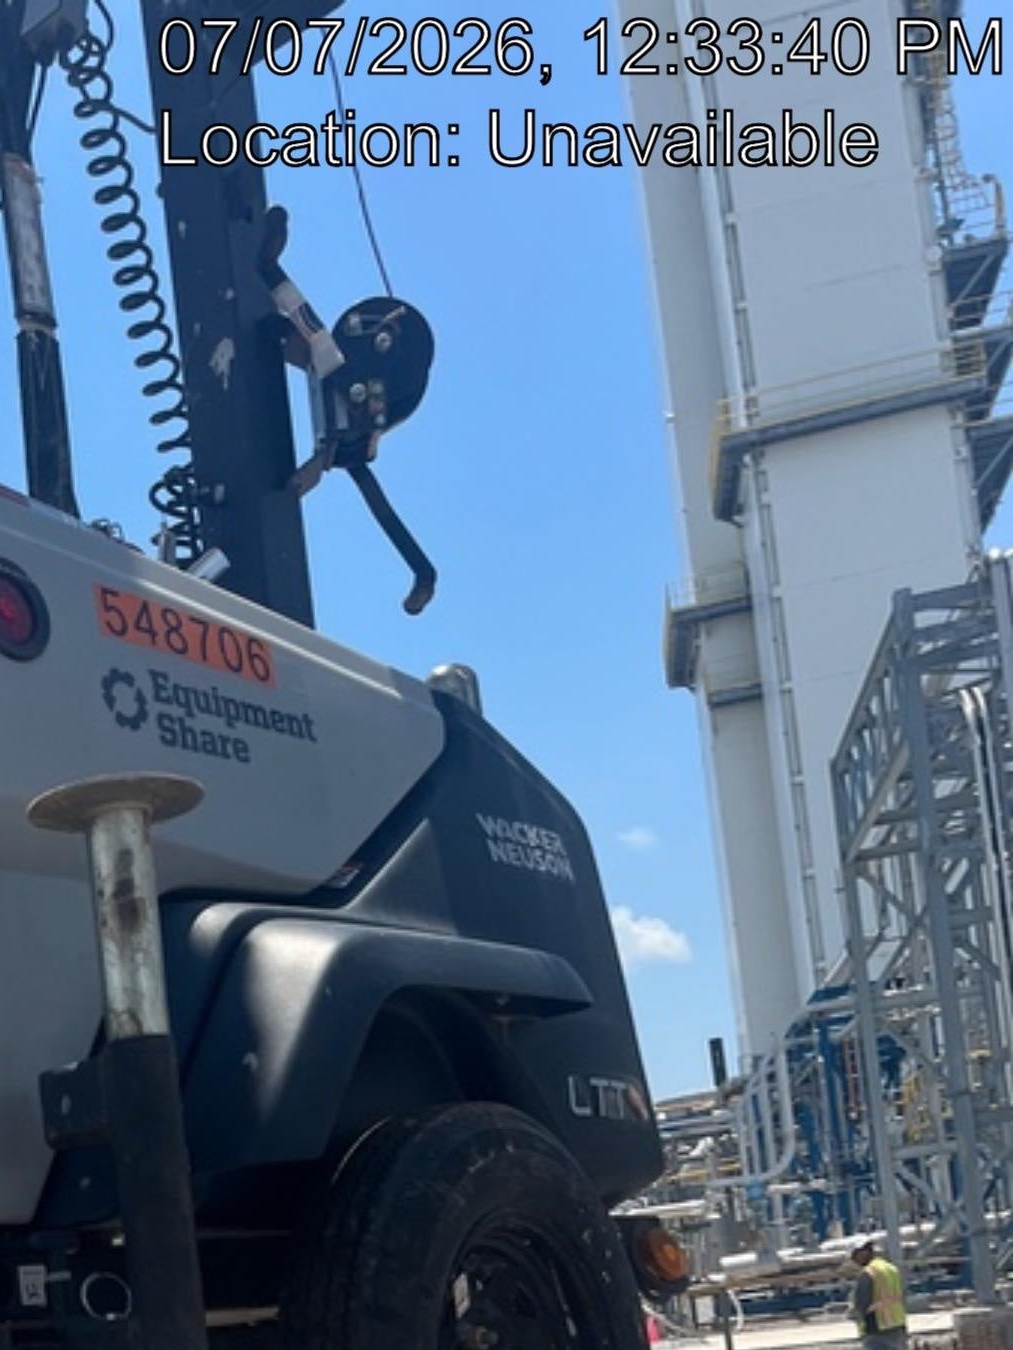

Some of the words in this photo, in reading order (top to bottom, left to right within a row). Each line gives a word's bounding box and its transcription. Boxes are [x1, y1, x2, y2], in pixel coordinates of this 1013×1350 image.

[100, 586, 271, 682] 548706
[148, 668, 317, 743] Equipment
[156, 712, 251, 763] Share
[475, 811, 567, 857] WACKER
[486, 838, 576, 884] NEUSON
